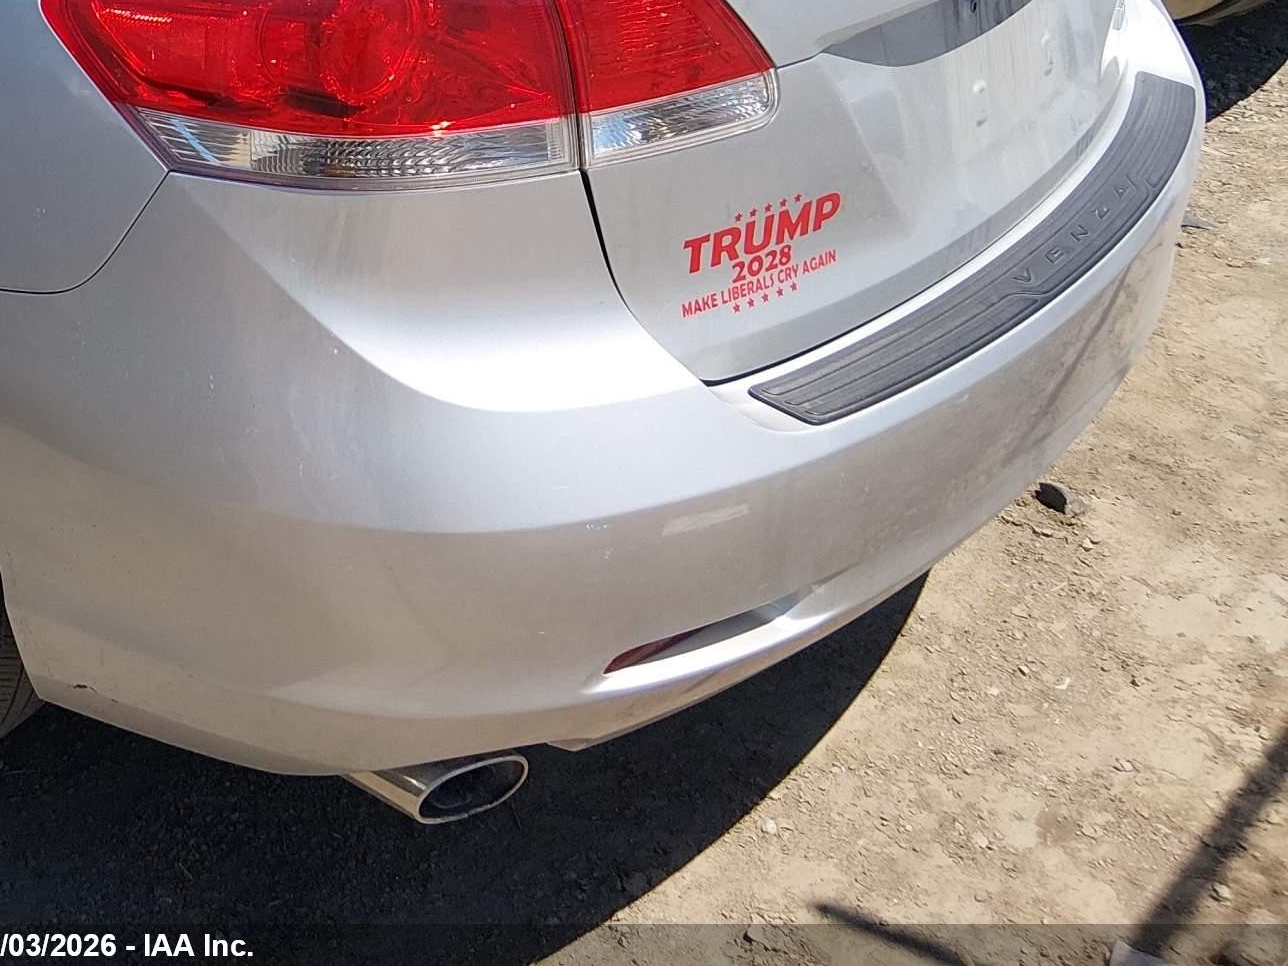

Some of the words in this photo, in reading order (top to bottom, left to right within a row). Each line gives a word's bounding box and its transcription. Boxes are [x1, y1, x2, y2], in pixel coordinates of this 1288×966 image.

[684, 192, 841, 274] TRUMP
[732, 244, 792, 283] 2028
[1013, 174, 1136, 283] VENZA
[681, 293, 718, 317] MAKE
[721, 273, 775, 305] LIBERALS
[777, 264, 799, 284] CRY
[802, 249, 836, 275] AGAIN
